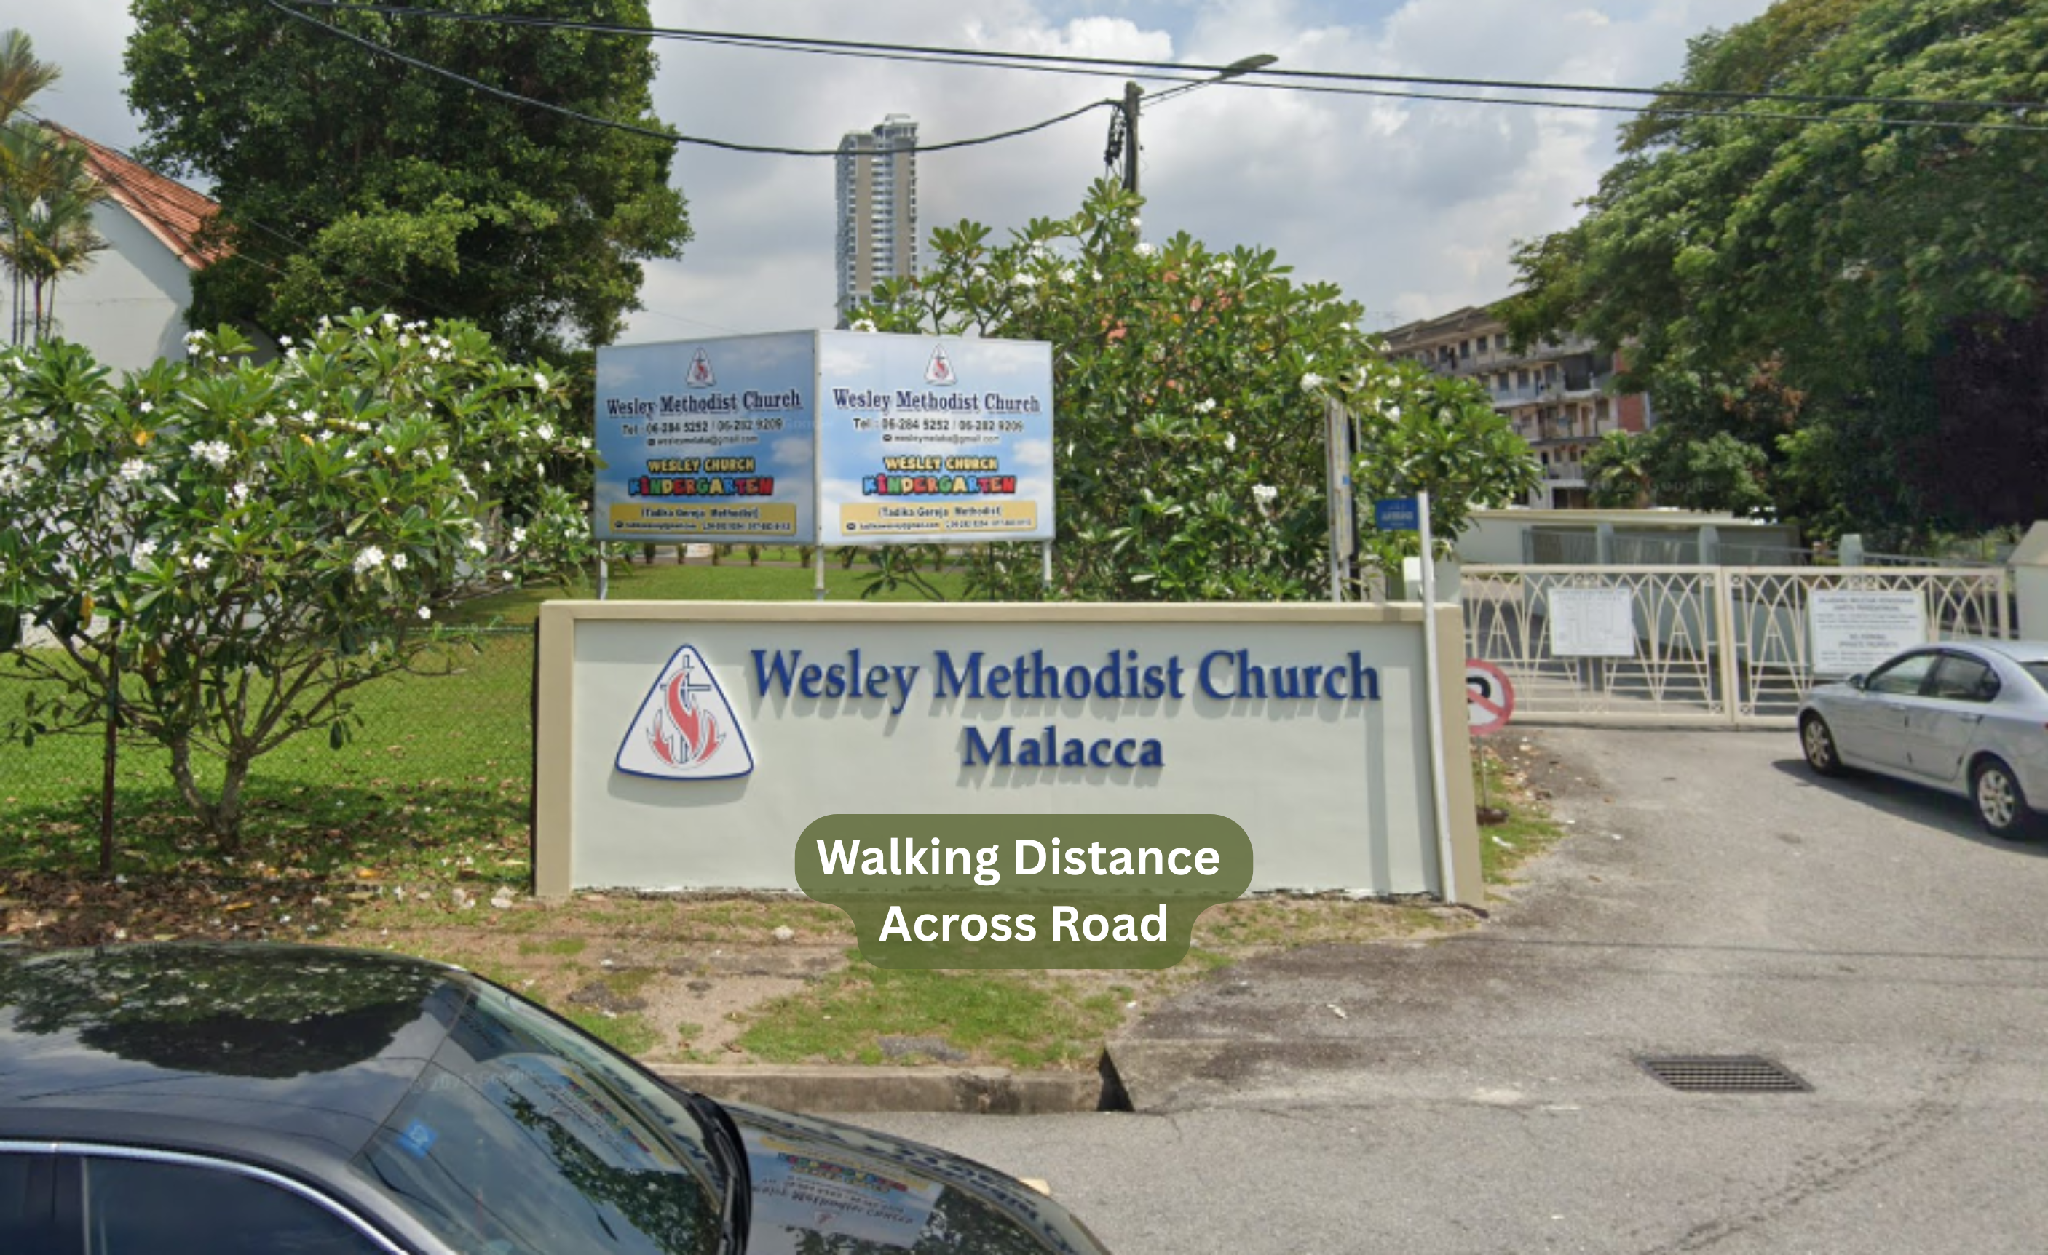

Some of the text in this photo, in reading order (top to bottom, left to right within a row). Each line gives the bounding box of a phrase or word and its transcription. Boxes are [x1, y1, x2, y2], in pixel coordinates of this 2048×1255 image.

[607, 389, 802, 418] Wesley Methodist Church
[833, 388, 1041, 415] Wesley Methodist Church
[853, 418, 871, 430] Tel
[647, 457, 756, 473] WESLEY CHURCH
[883, 455, 998, 472] WESLEY CHURCH
[751, 649, 1380, 715] Wesley Methodist Church
[962, 725, 1164, 768] Malacca
